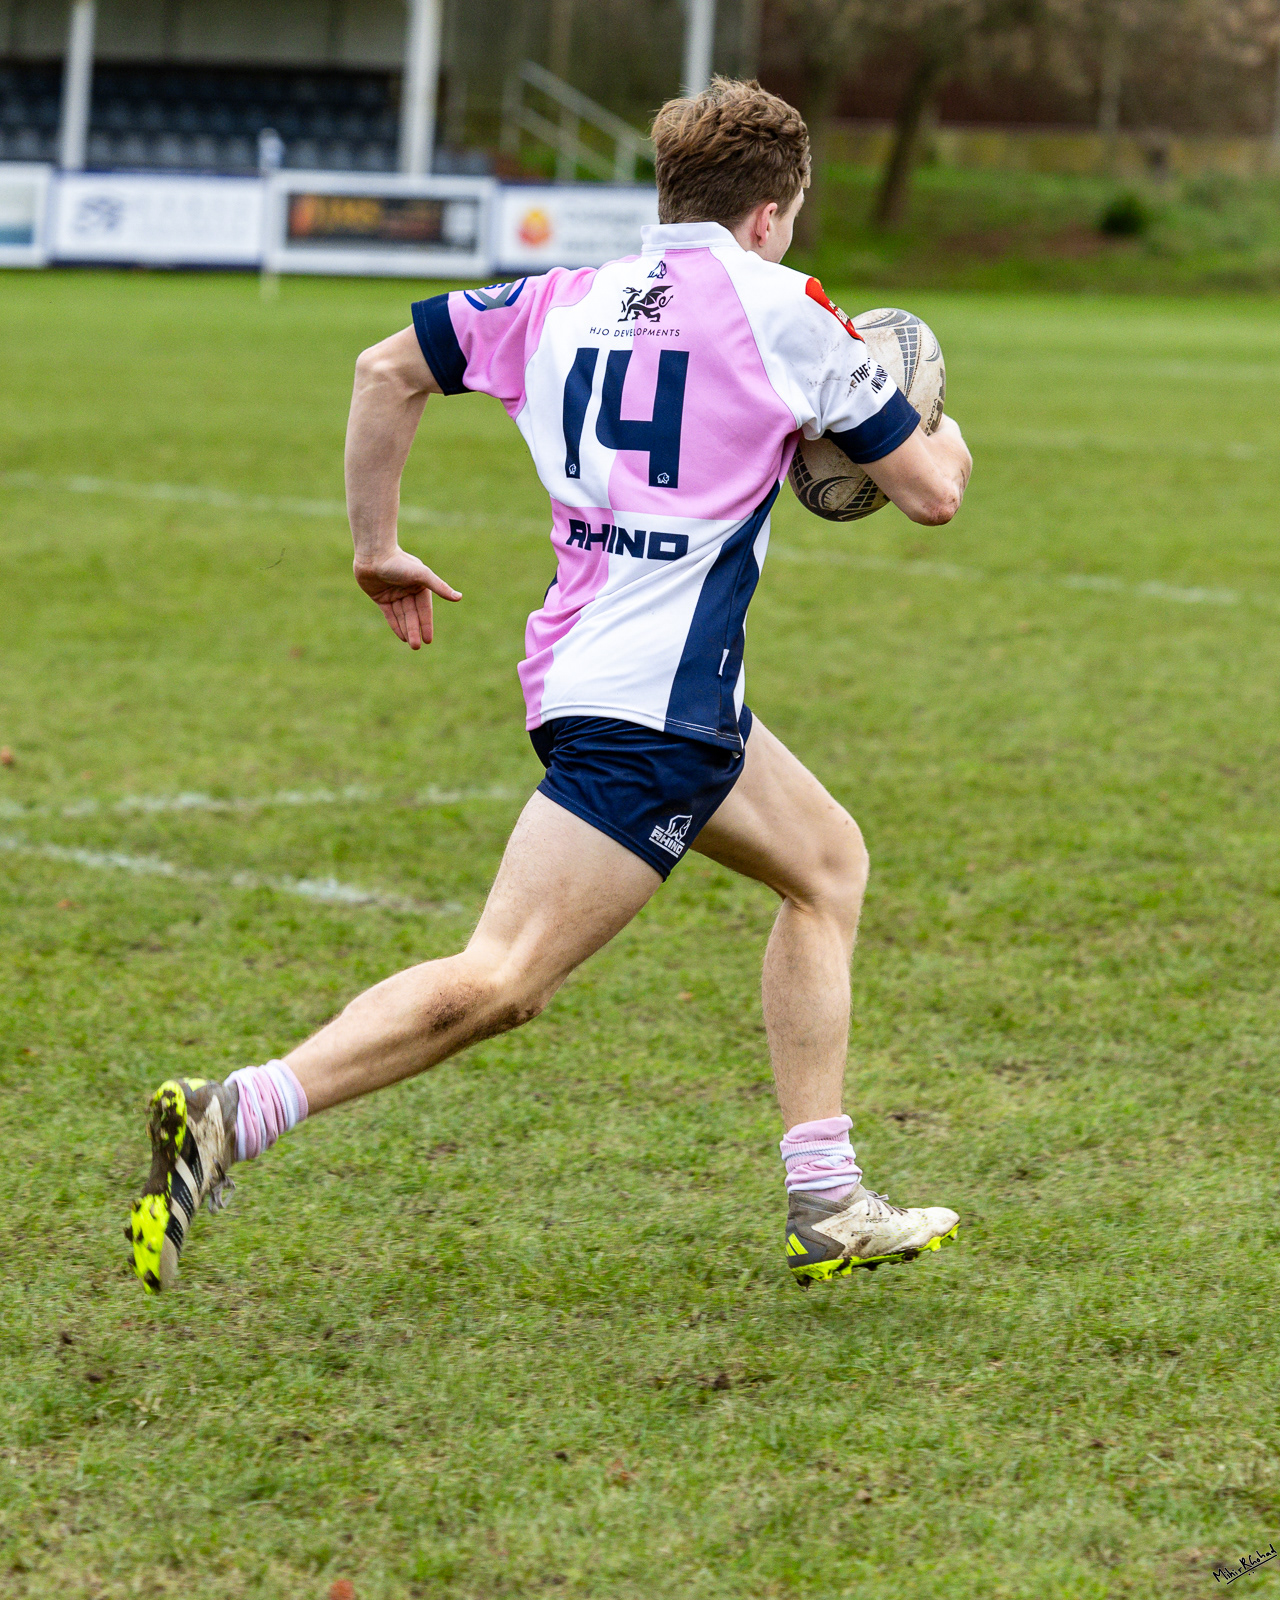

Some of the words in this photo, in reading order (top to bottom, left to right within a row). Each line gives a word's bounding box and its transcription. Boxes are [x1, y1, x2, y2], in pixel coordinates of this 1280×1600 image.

[589, 326, 610, 336] HJO
[613, 327, 681, 338] DEVELOPMENTS
[562, 347, 690, 489] 14
[565, 518, 690, 561] RHINO
[650, 829, 684, 855] RHINO
